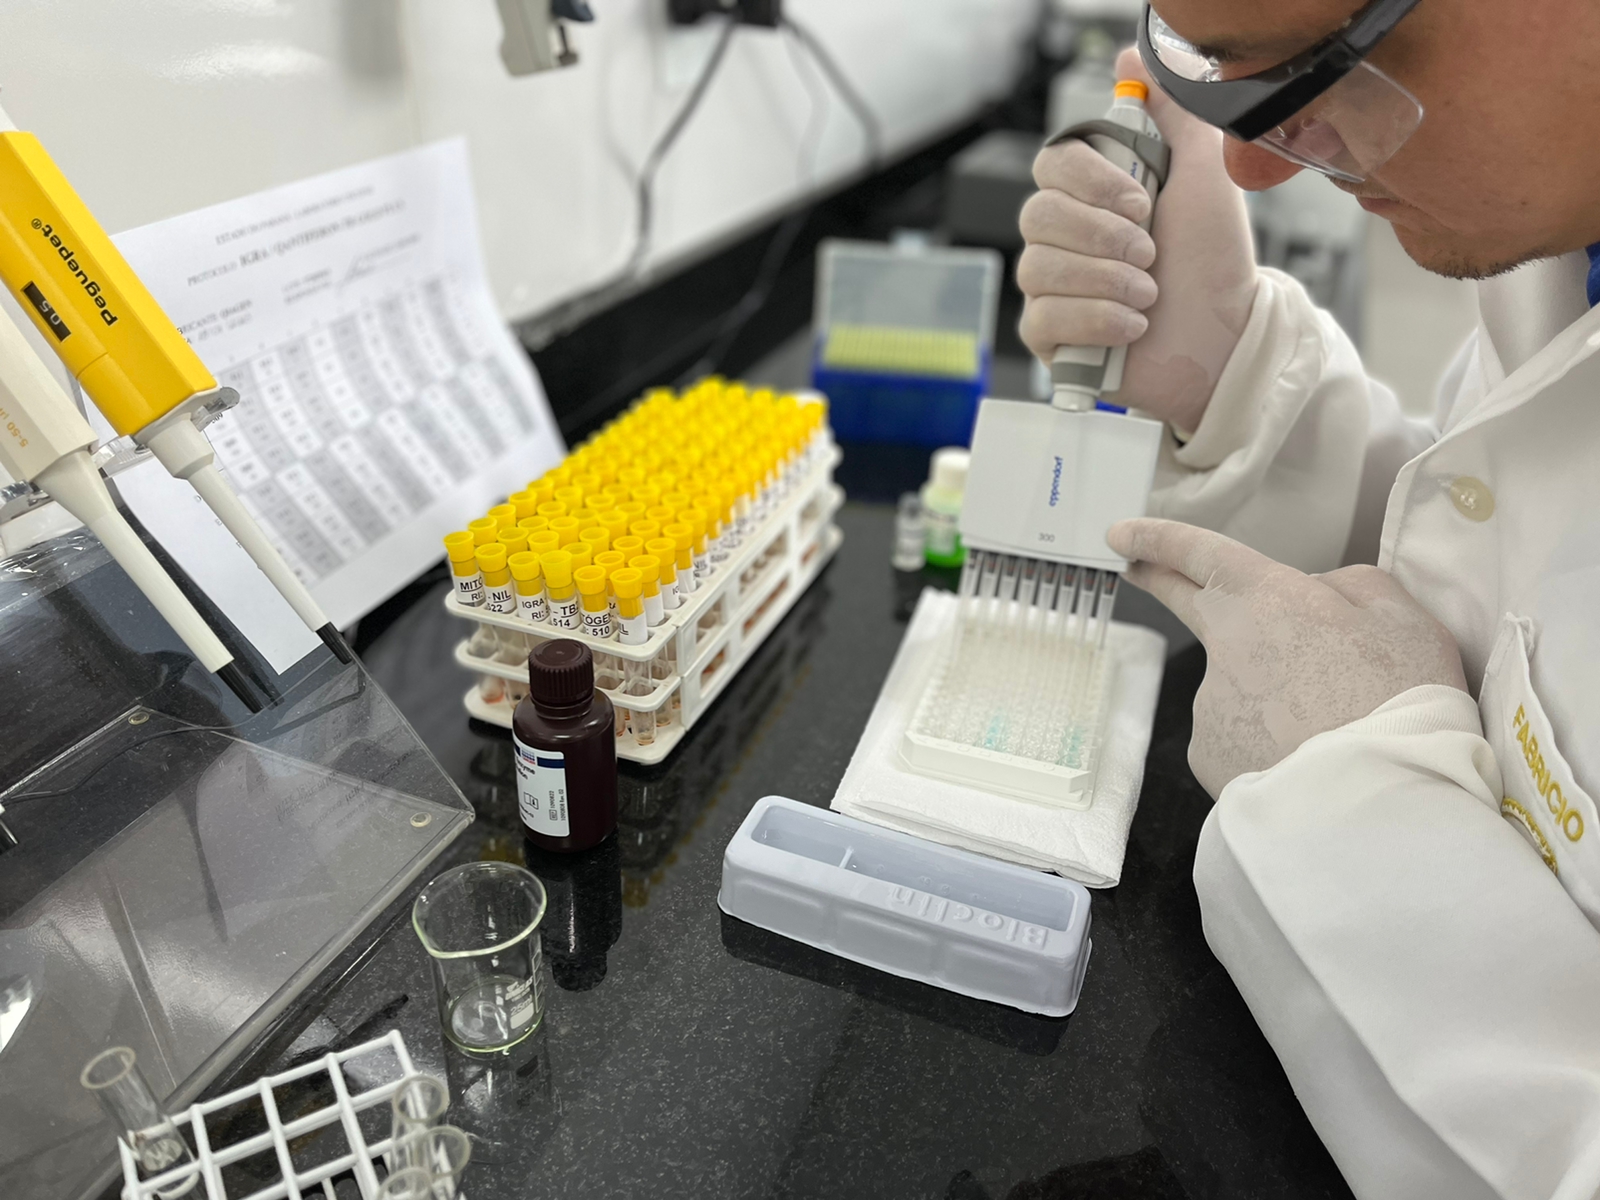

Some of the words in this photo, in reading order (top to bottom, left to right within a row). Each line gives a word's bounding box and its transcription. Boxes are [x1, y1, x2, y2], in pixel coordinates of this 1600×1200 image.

[1048, 455, 1064, 507] eppendorf
[1038, 532, 1055, 543] 300
[492, 590, 512, 601] NIL
[521, 598, 545, 609] IGRA
[531, 610, 545, 620] RI:
[552, 618, 571, 628] 514
[592, 626, 610, 637] 510
[1512, 702, 1584, 843] FABRICIO
[887, 885, 1049, 951] Bioclin
